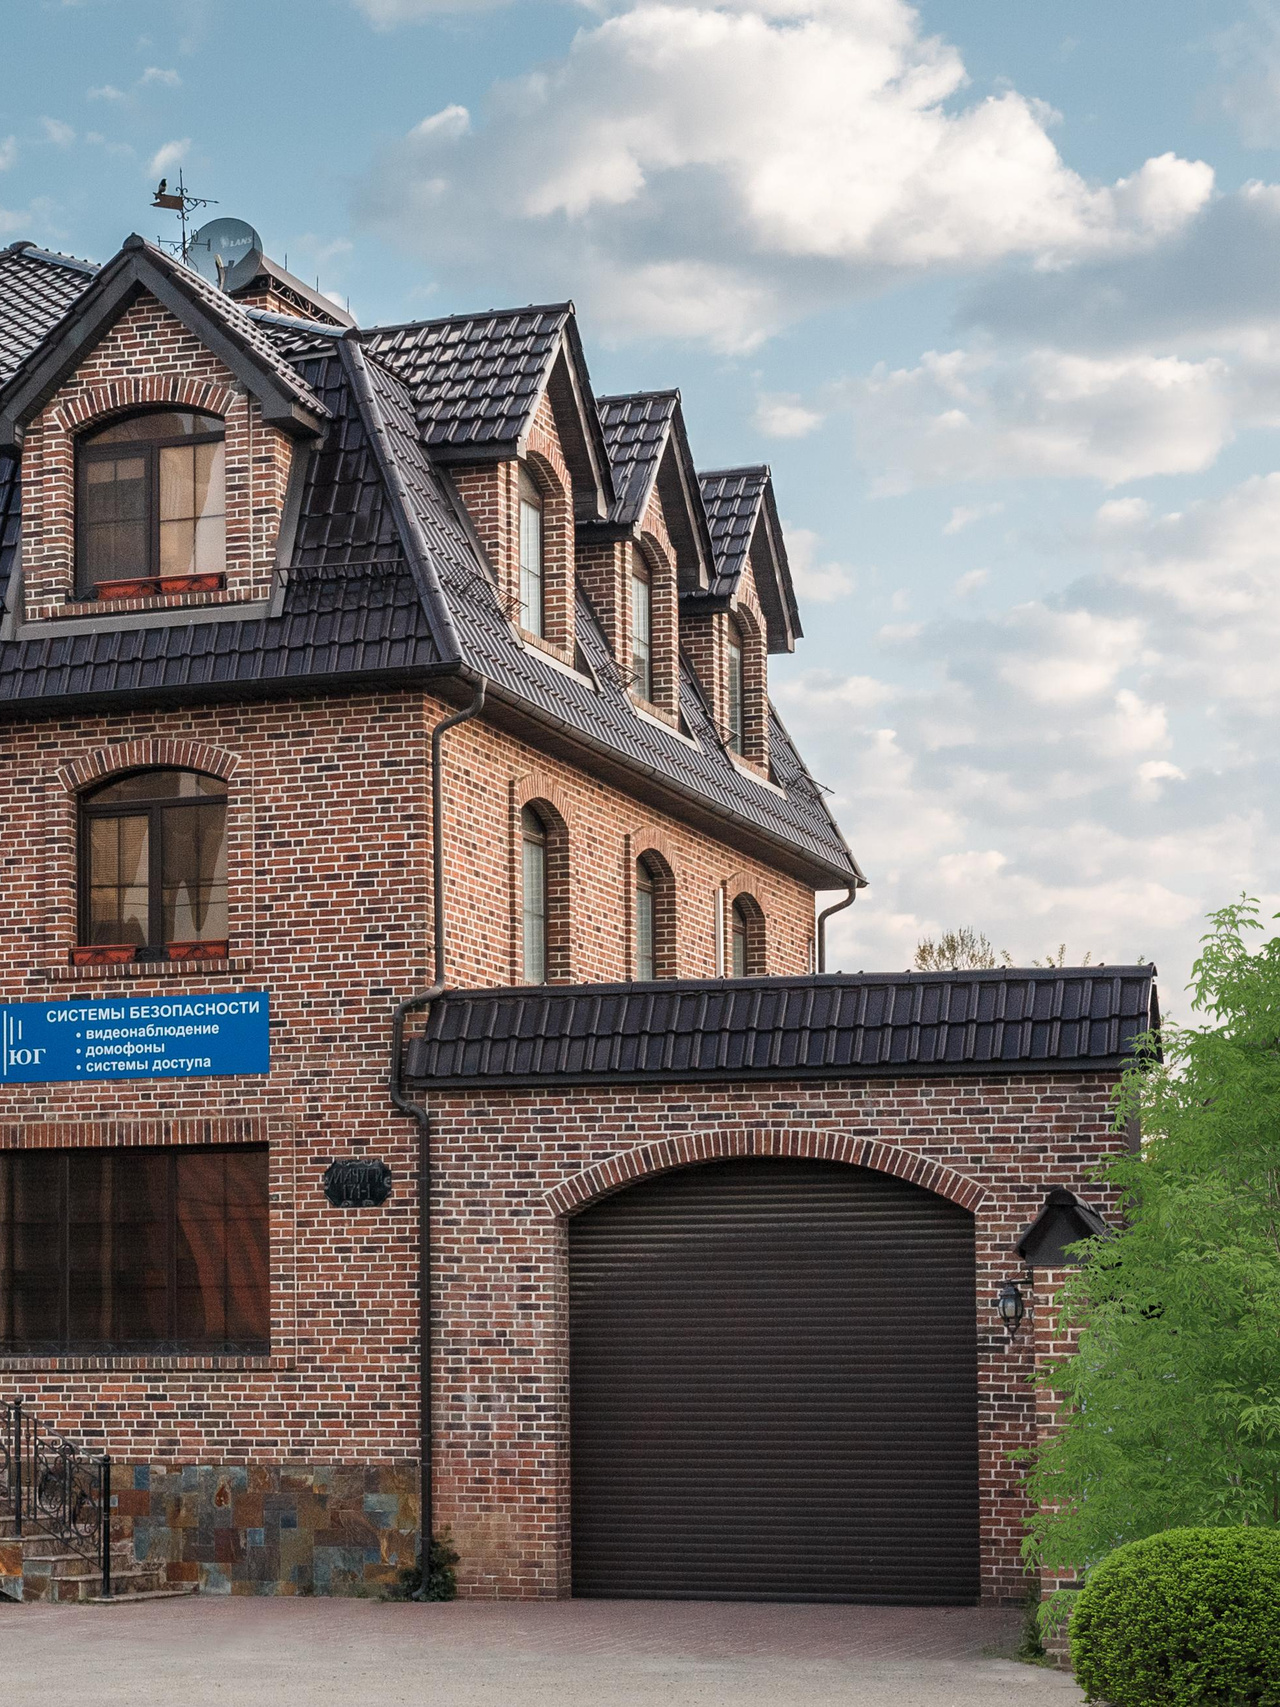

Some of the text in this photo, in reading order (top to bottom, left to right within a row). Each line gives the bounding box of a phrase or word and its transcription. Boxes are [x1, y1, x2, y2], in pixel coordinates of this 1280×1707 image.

[46, 1001, 260, 1023] СИСТЕМЫ БЕЗОПАСНОСТИ
[86, 1024, 220, 1041] видеонаблюдение
[8, 1048, 46, 1066] ЮГ
[85, 1041, 165, 1058] домофоны
[86, 1057, 212, 1073] системы доступа
